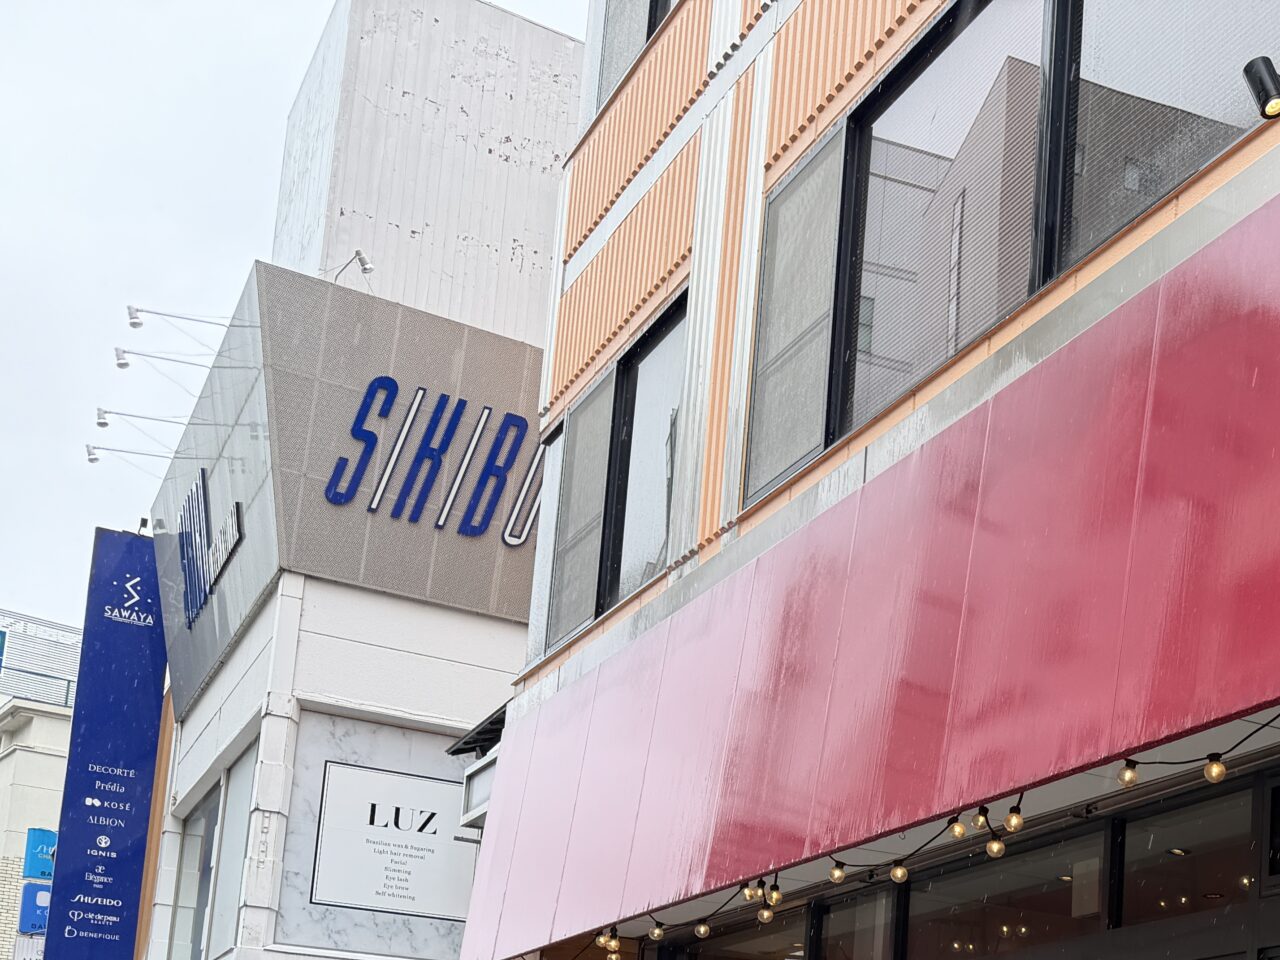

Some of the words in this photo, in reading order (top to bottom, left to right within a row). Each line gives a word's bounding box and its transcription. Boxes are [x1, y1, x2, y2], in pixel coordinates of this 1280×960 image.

[104, 605, 154, 625] SAWAYA
[88, 763, 136, 778] DECORTÉ
[95, 781, 125, 793] Prédia
[86, 815, 126, 828] ALBION
[366, 802, 438, 835] LUZ
[87, 848, 117, 858] IGNIS
[373, 847, 389, 855] Light
[70, 894, 122, 907] SHISEIDO
